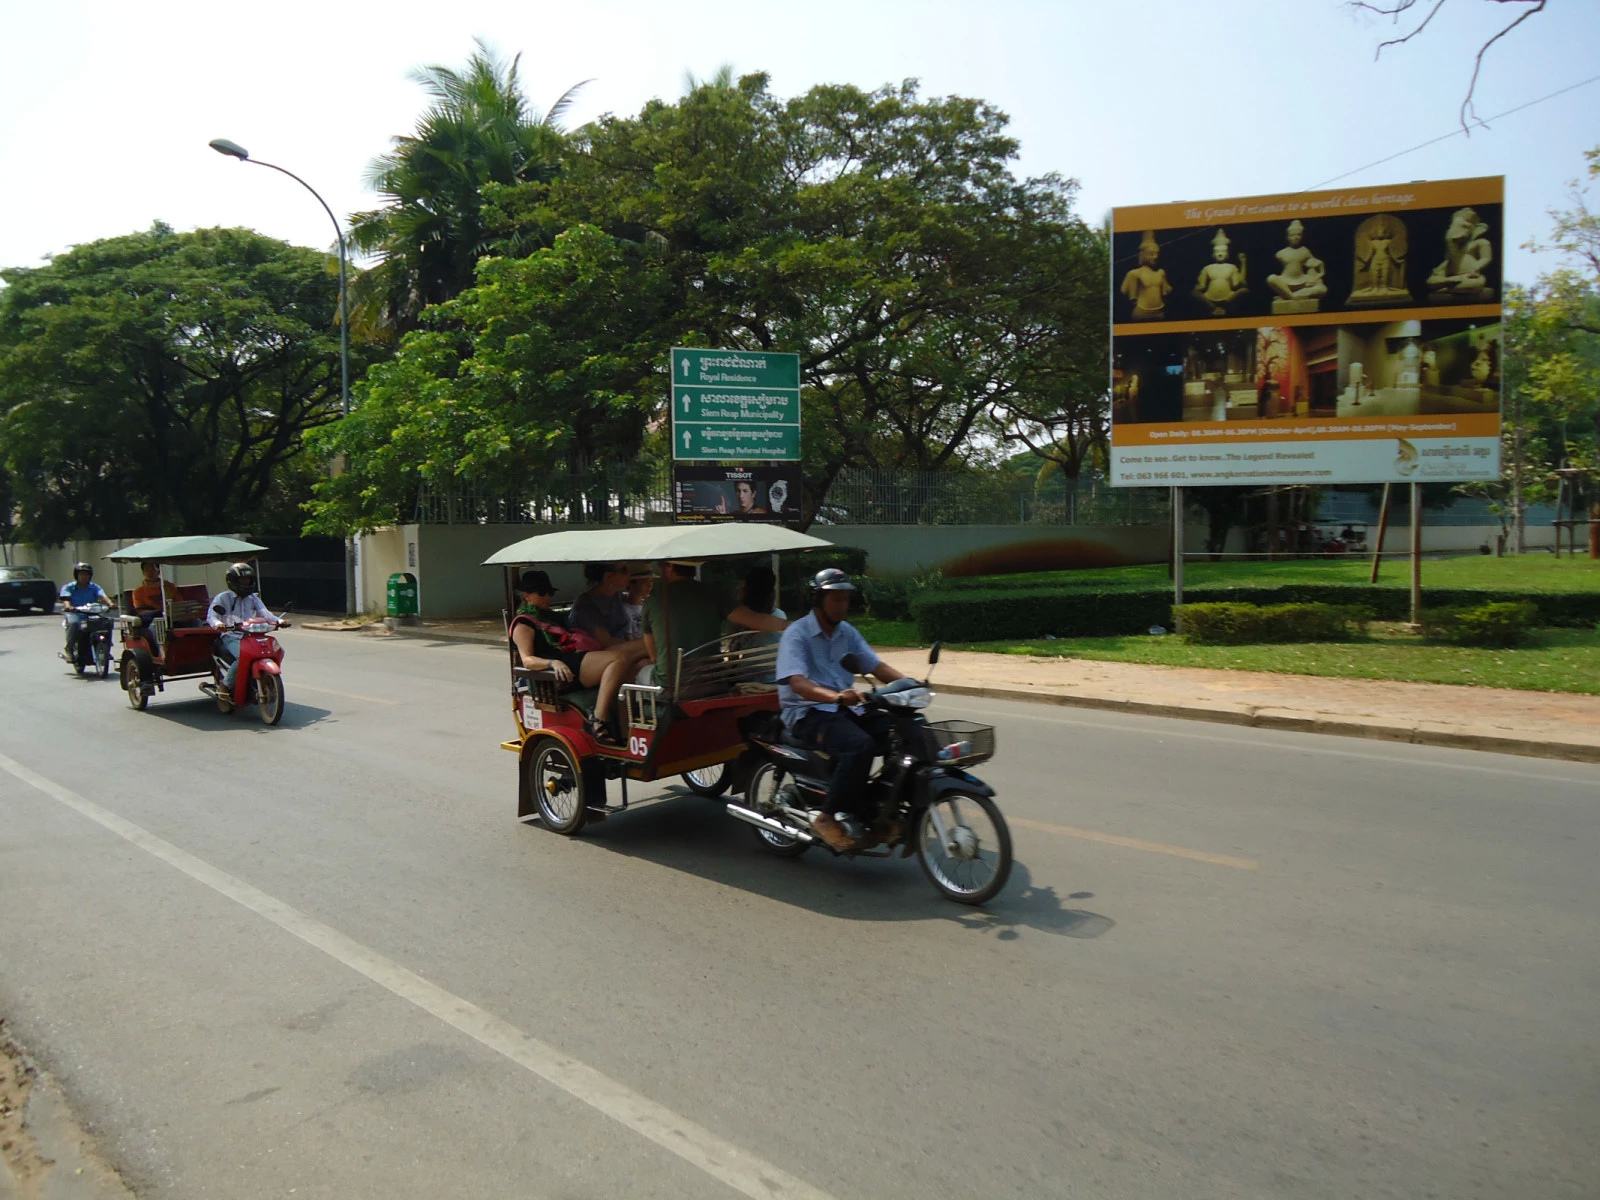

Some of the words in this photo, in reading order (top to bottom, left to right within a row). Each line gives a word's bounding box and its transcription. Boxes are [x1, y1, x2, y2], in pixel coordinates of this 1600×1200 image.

[700, 372, 720, 383] Royal
[721, 373, 757, 382] Residence
[701, 408, 720, 417] Siem
[721, 409, 739, 419] Reap
[741, 409, 784, 420] Municipality
[701, 446, 718, 454] Siem
[629, 736, 648, 756] 05
